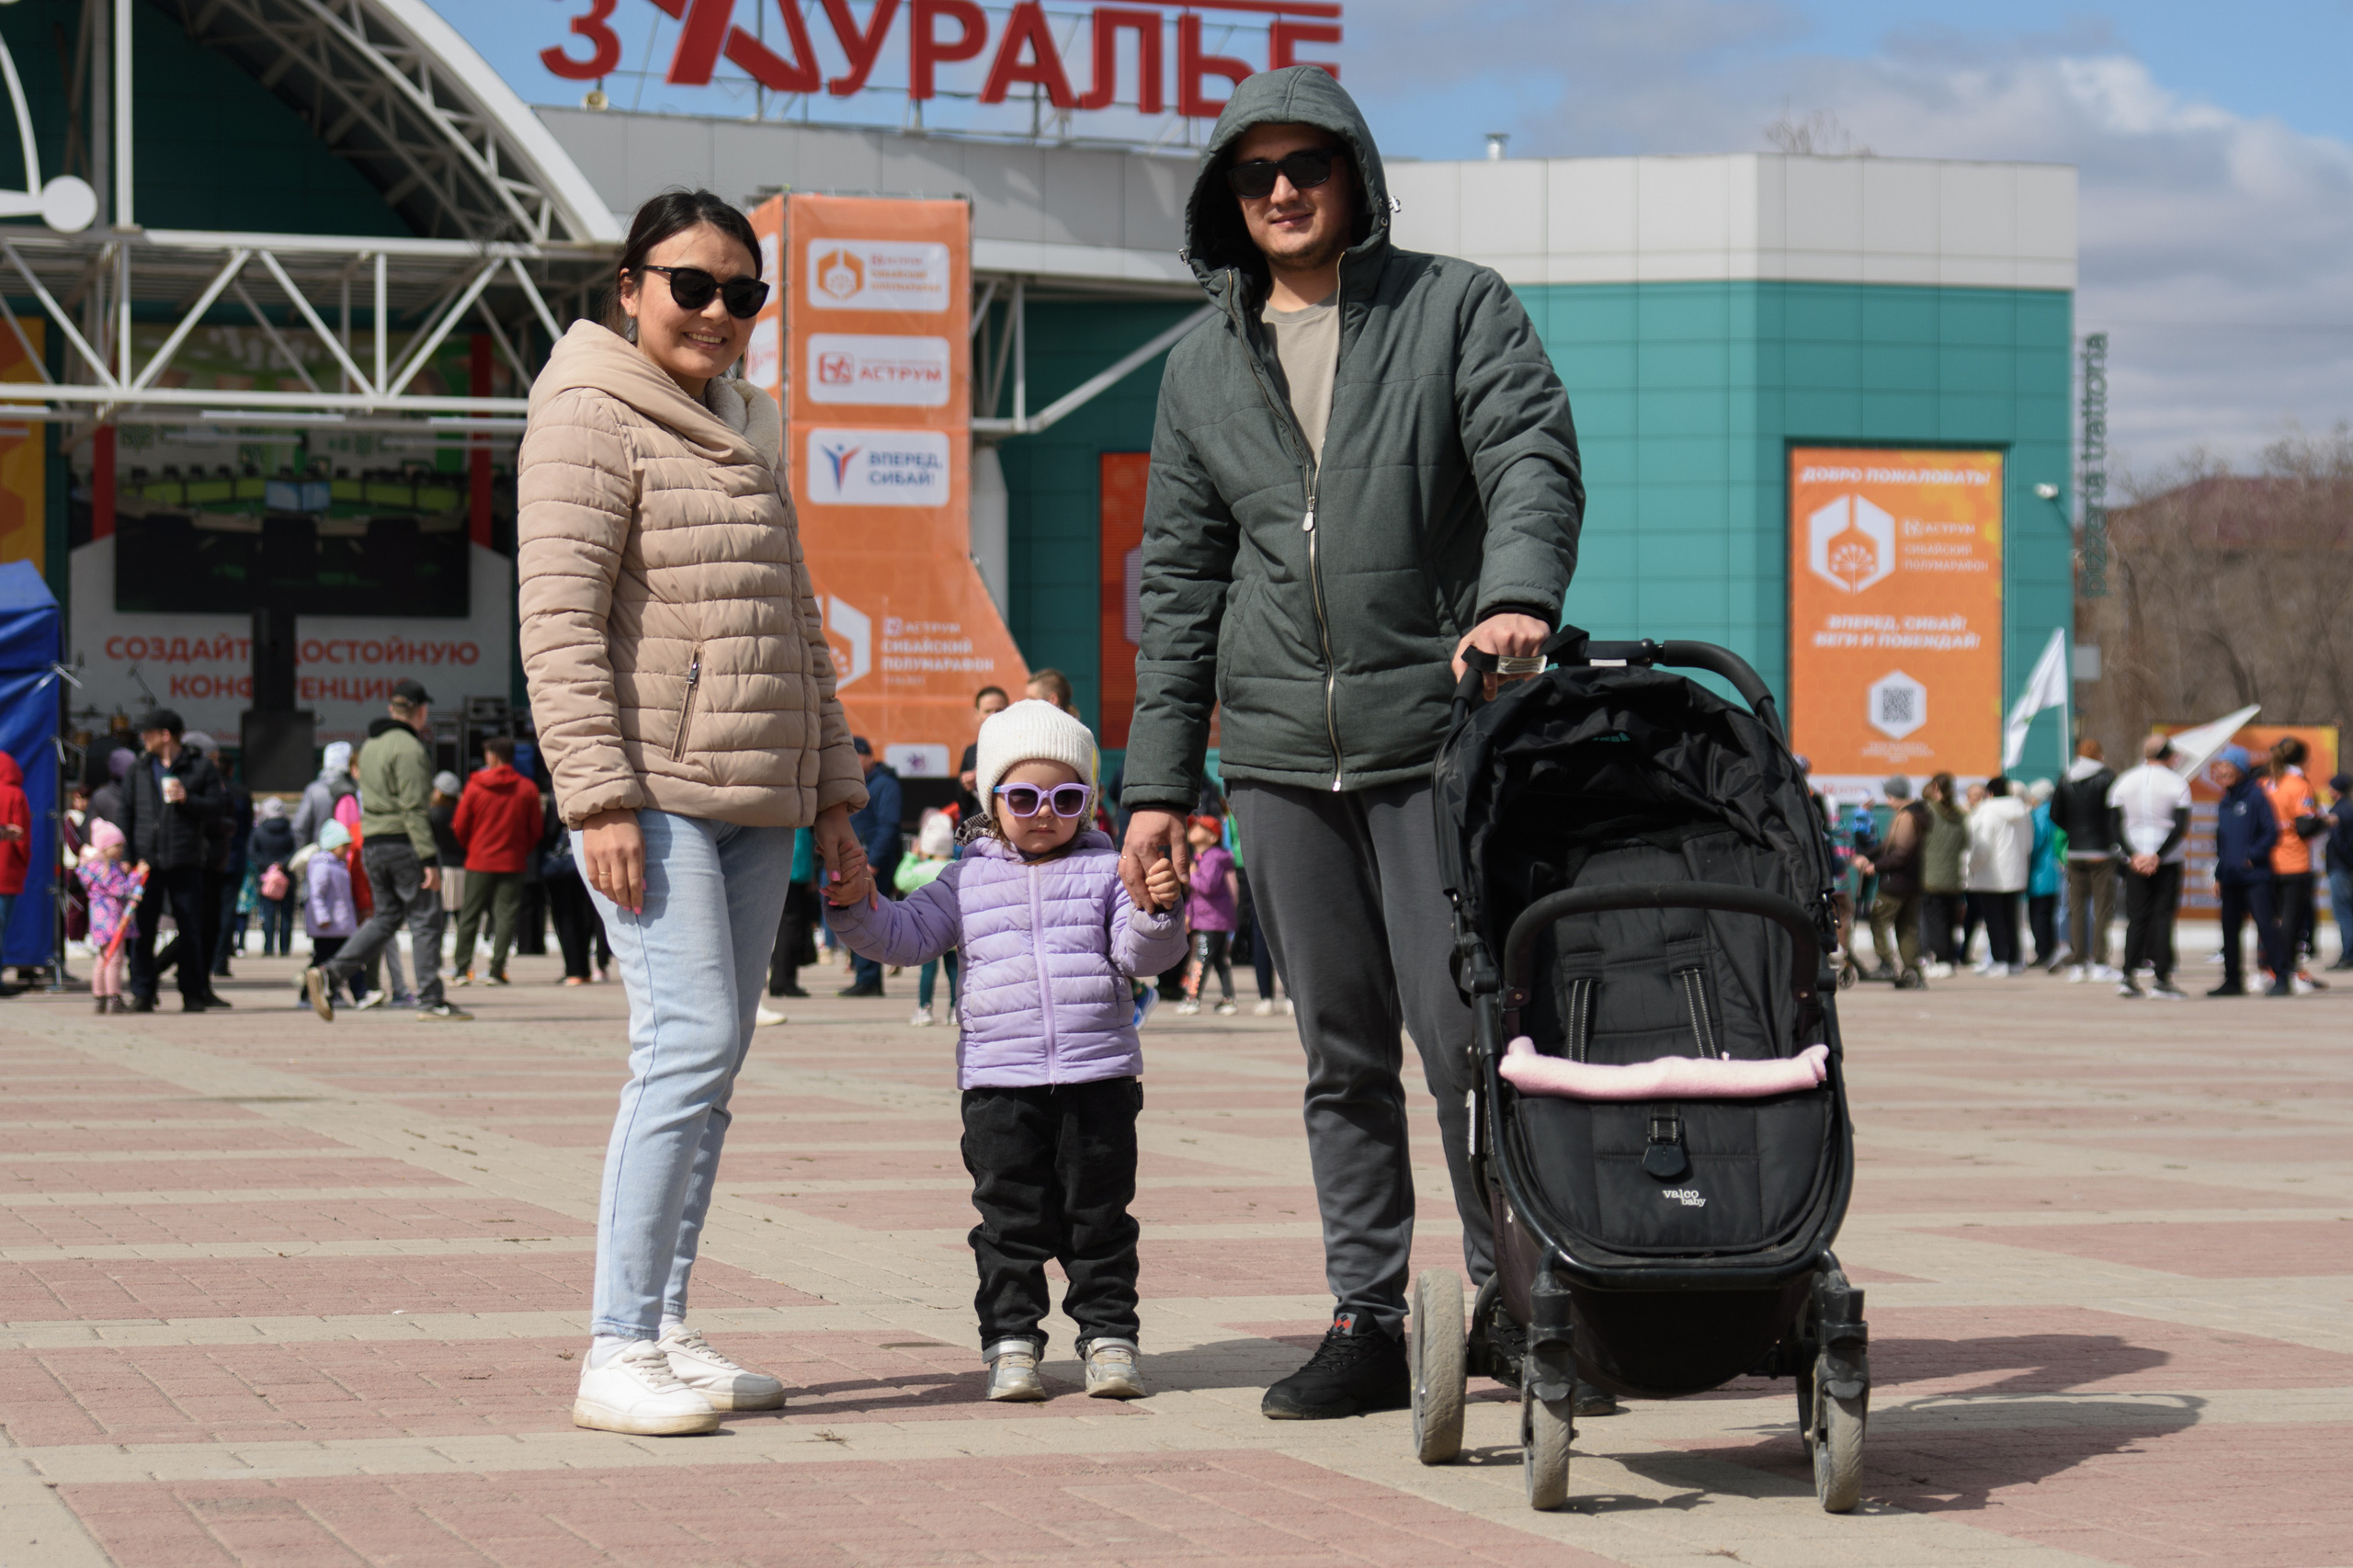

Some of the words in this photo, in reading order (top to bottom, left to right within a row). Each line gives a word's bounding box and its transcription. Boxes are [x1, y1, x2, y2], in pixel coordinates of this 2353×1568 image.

[860, 367, 941, 382] АСТРУМ
[2081, 332, 2108, 462] trattoria
[1802, 466, 1863, 484] ДОБРО
[1866, 467, 1991, 485] ПОЖАЛОВАТЬ!
[1925, 521, 1976, 535] АСТРУМ
[1905, 542, 1972, 556] СИБАЙСКИЙ
[1905, 560, 1988, 574] ПОЛУМАРАФОН
[905, 621, 961, 634] АСТРУМ
[1829, 615, 1900, 631] ВПЕРЕД,
[1904, 614, 1967, 631] СИБАЙ!
[105, 632, 254, 665] СОЗДАЙТ
[296, 635, 481, 667] ОСТОЙНУЮ
[881, 637, 972, 653] СИБАЙСКИЙ
[881, 656, 994, 672] ПОЛУМАРАФОН
[1663, 1189, 1699, 1199] valco
[1681, 1199, 1706, 1207] baby
